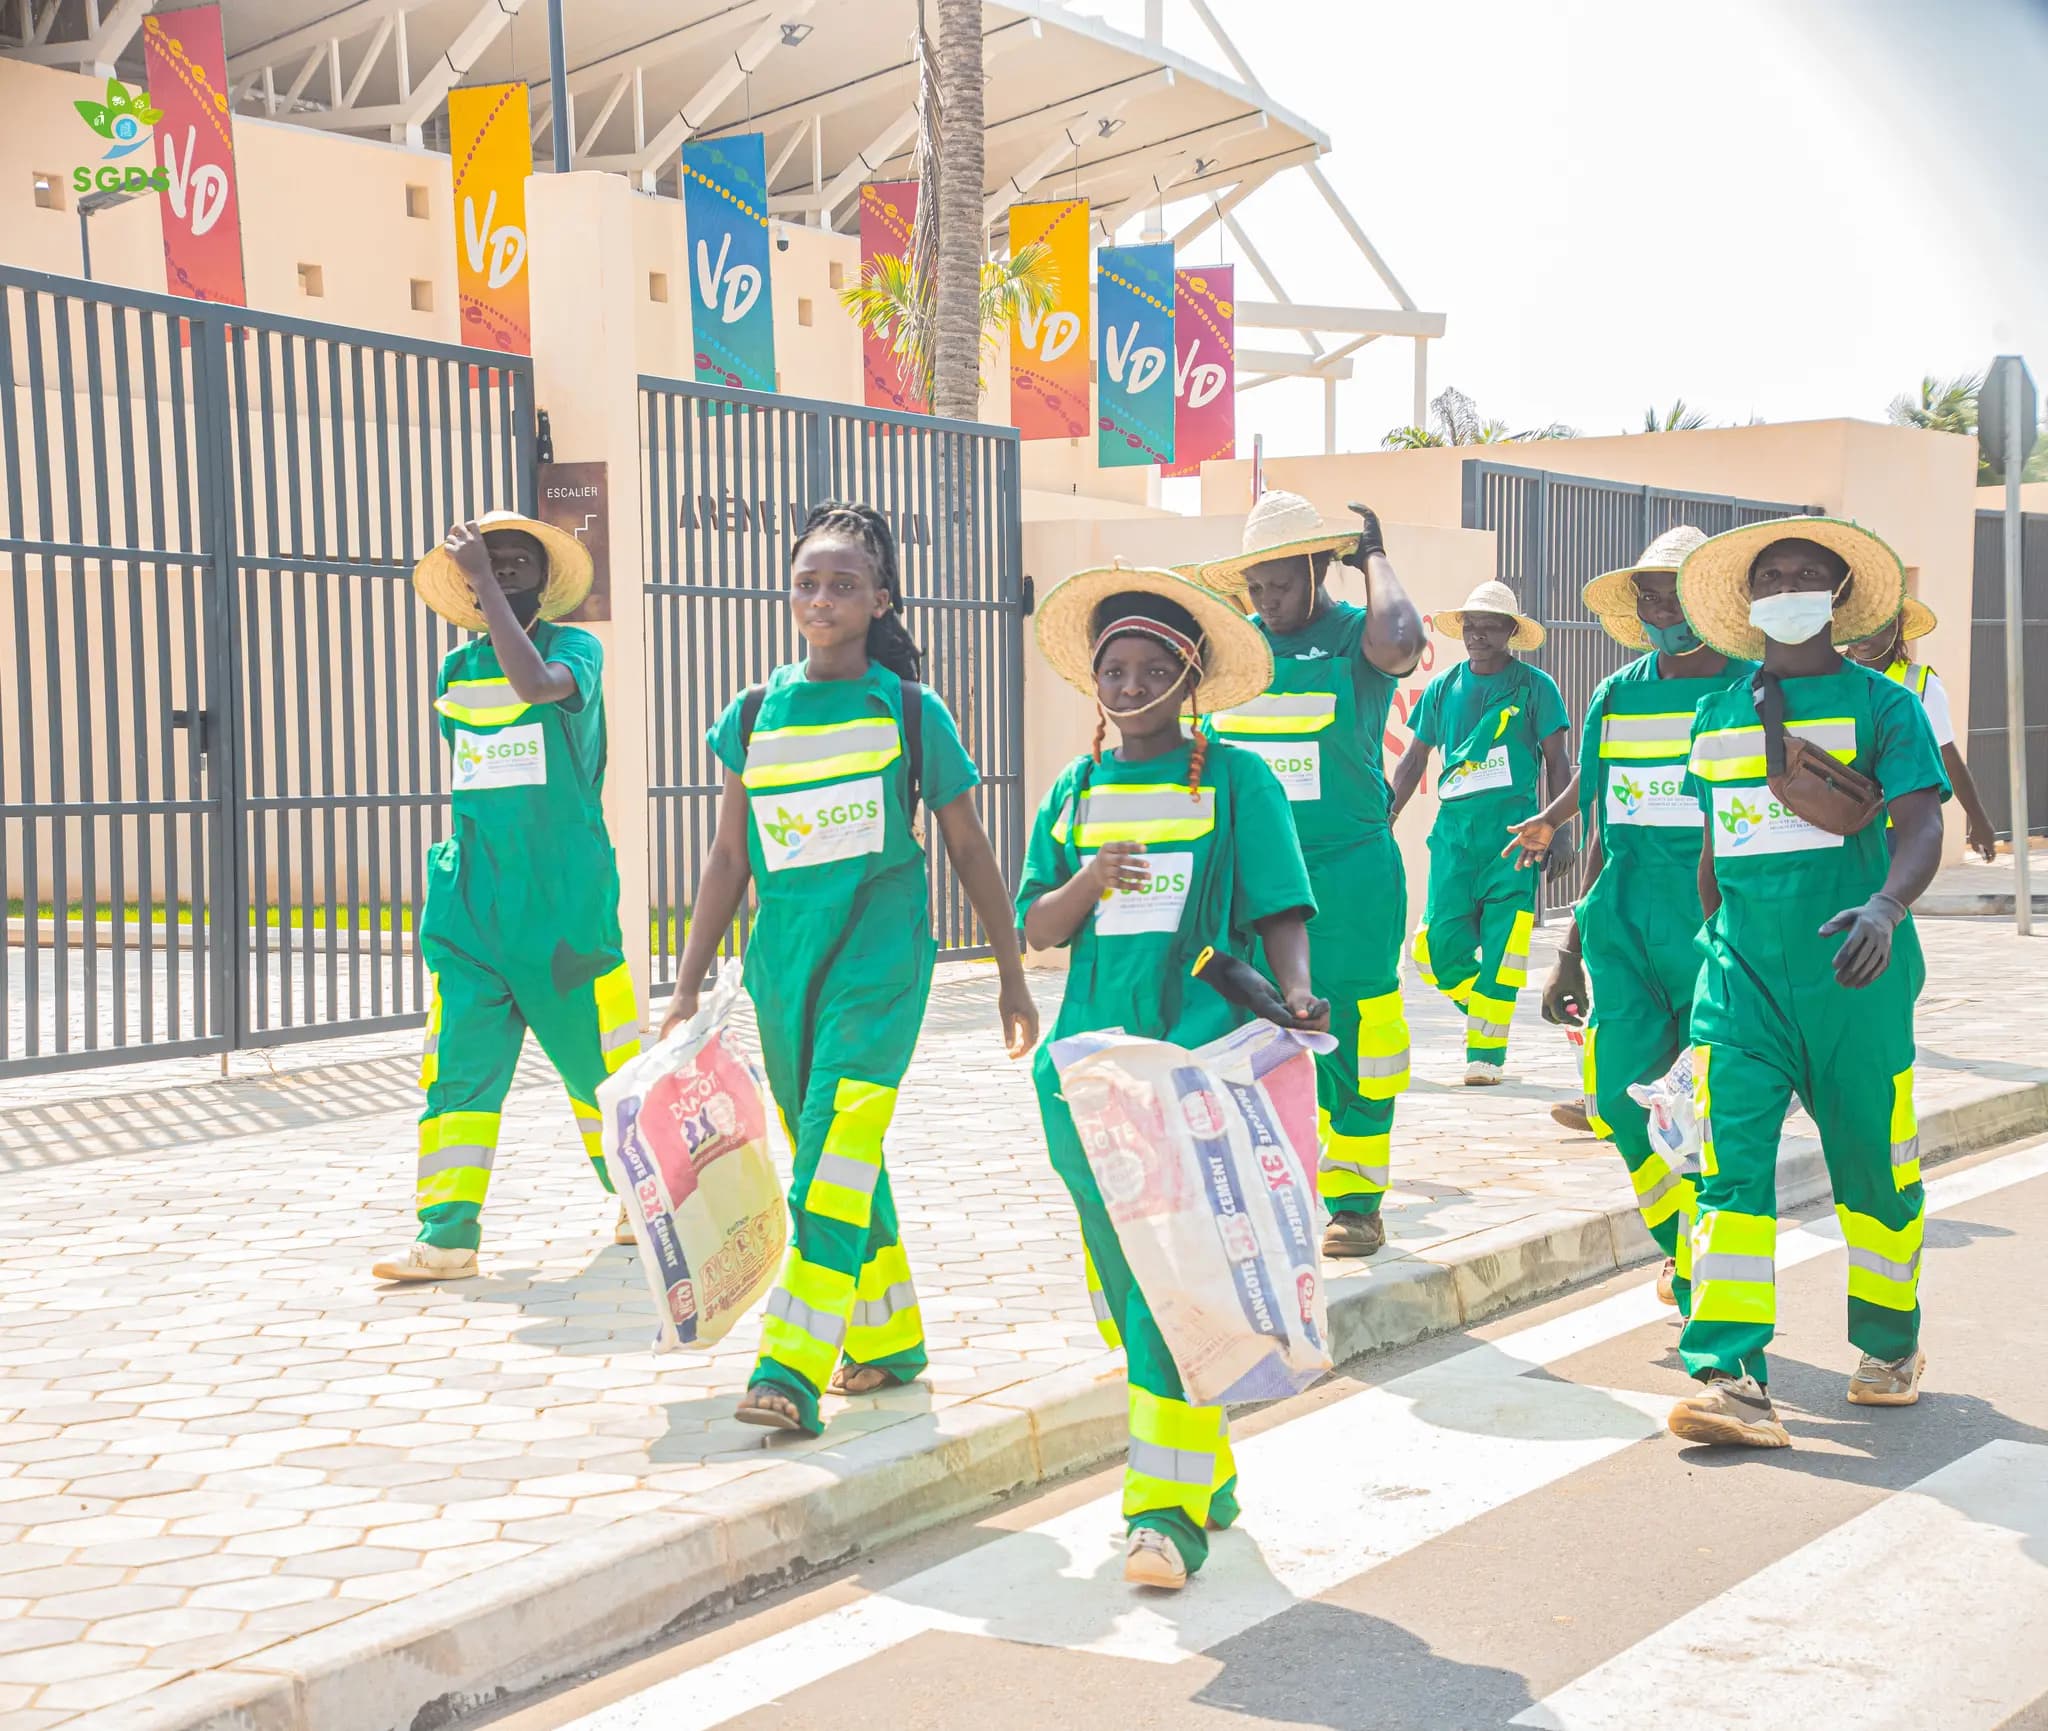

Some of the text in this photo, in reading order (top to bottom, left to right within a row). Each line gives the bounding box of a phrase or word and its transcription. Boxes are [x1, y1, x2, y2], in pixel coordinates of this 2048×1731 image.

[464, 190, 527, 288] VD
[697, 232, 762, 323] VD
[1106, 320, 1166, 394] VD
[547, 486, 598, 498] ESCALIER
[486, 740, 538, 759] SGDS
[1471, 757, 1505, 772] SGDS
[816, 800, 878, 828] SGDS
[1208, 1155, 1237, 1217] CEMENT
[1260, 1152, 1291, 1192] 3X
[640, 1180, 664, 1221] 3X
[654, 1217, 679, 1268] CEMENT
[1239, 1258, 1274, 1332] DANGOTE
